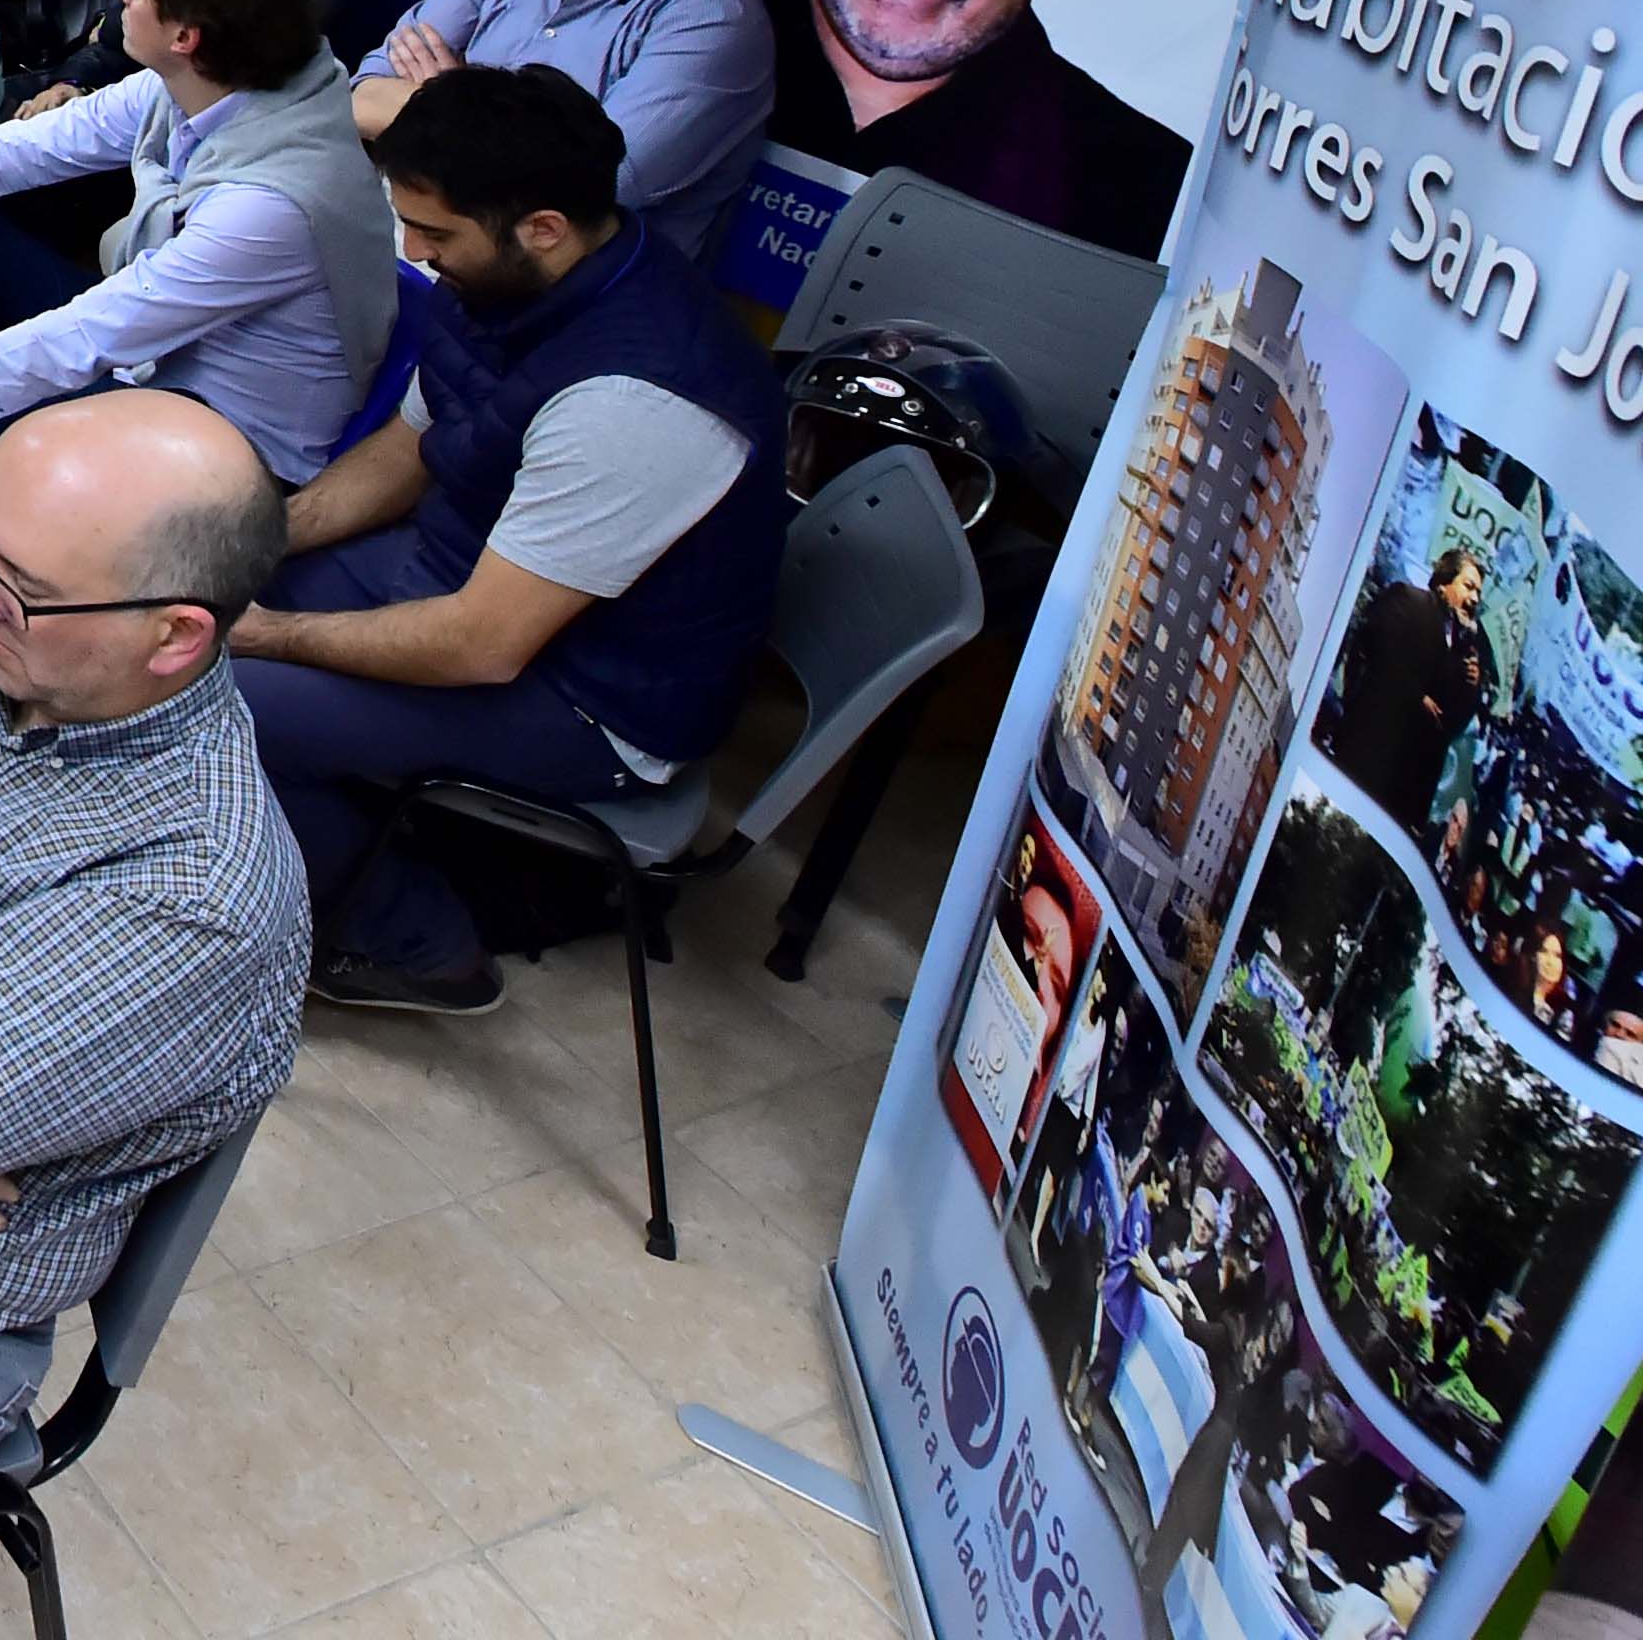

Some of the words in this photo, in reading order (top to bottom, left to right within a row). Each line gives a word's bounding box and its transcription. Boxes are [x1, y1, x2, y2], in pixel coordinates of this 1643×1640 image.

[748, 183, 833, 230] retar
[1225, 40, 1384, 223] orres
[1390, 153, 1539, 342] San
[1556, 269, 1643, 424] Jo
[876, 1266, 931, 1429] Siempre
[924, 1432, 939, 1465] a
[936, 1463, 961, 1520] tu
[953, 1515, 988, 1639] lado.
[1017, 1415, 1048, 1518] Red
